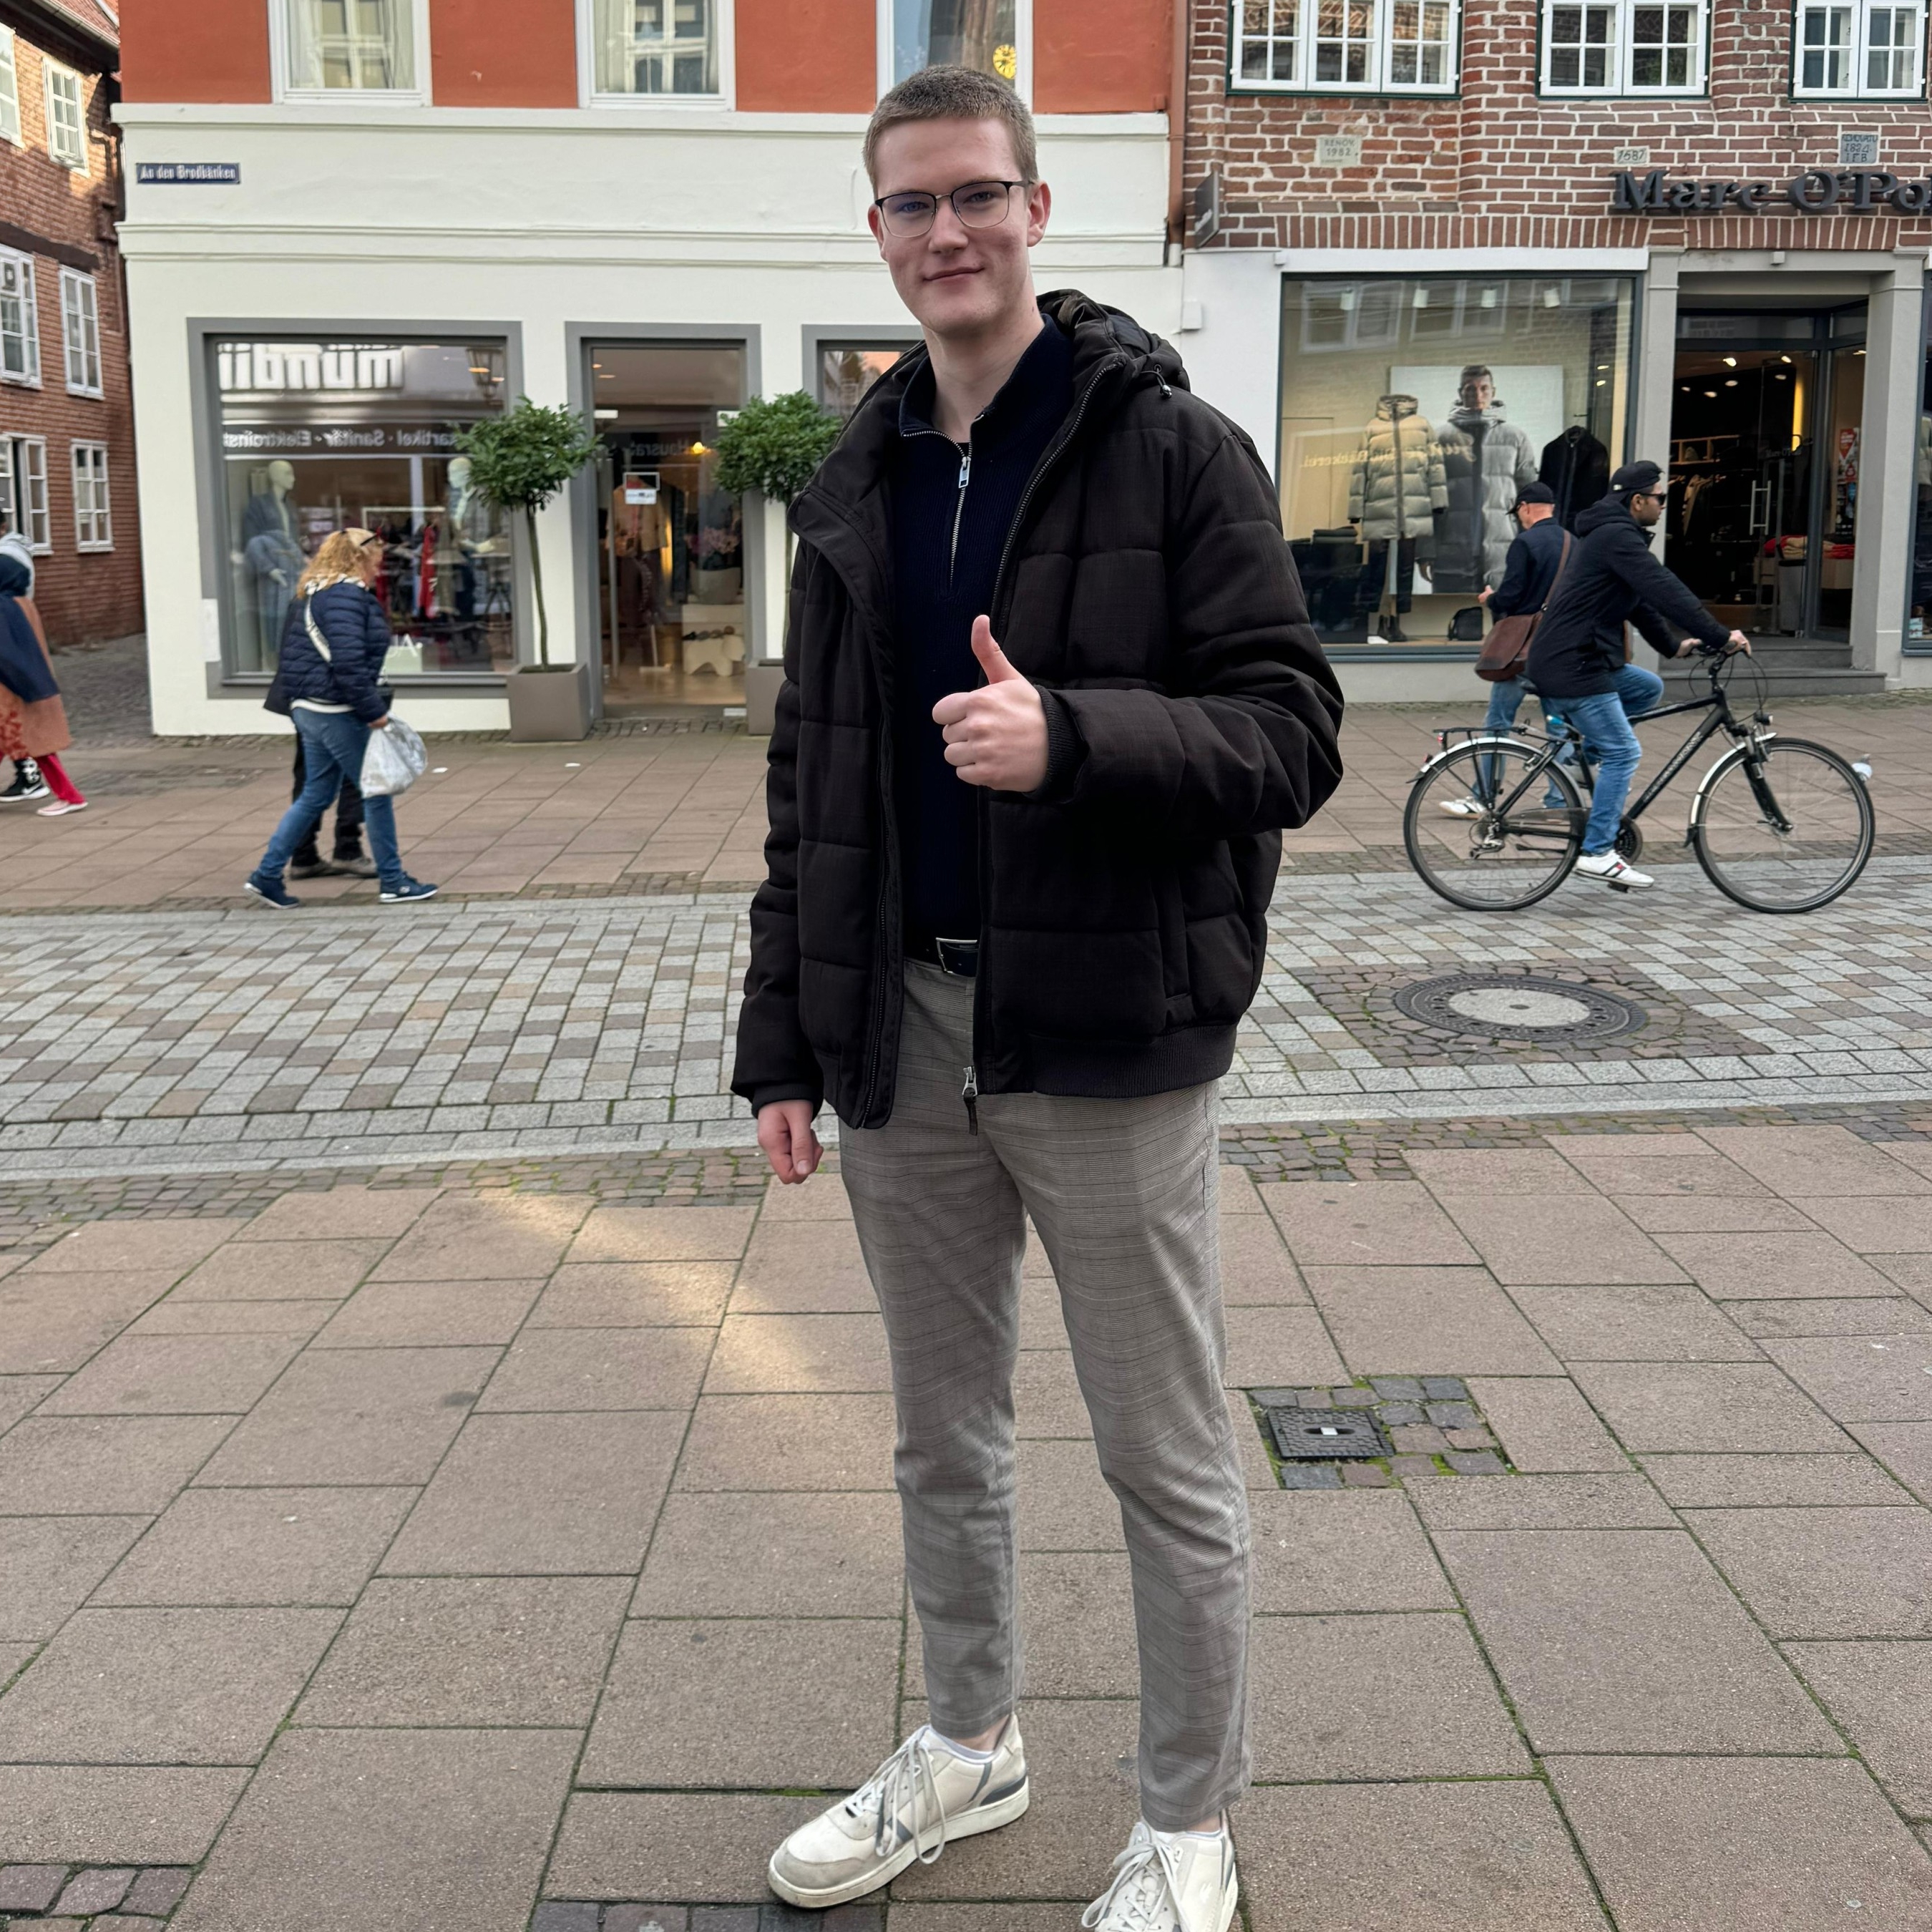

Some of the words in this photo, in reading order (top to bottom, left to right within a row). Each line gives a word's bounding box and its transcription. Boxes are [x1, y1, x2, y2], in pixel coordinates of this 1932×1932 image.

[140, 165, 155, 179] An
[156, 165, 175, 179] den
[176, 165, 236, 179] Brodbänken
[1609, 170, 1771, 210] Marc
[1789, 170, 1932, 211] O'Po
